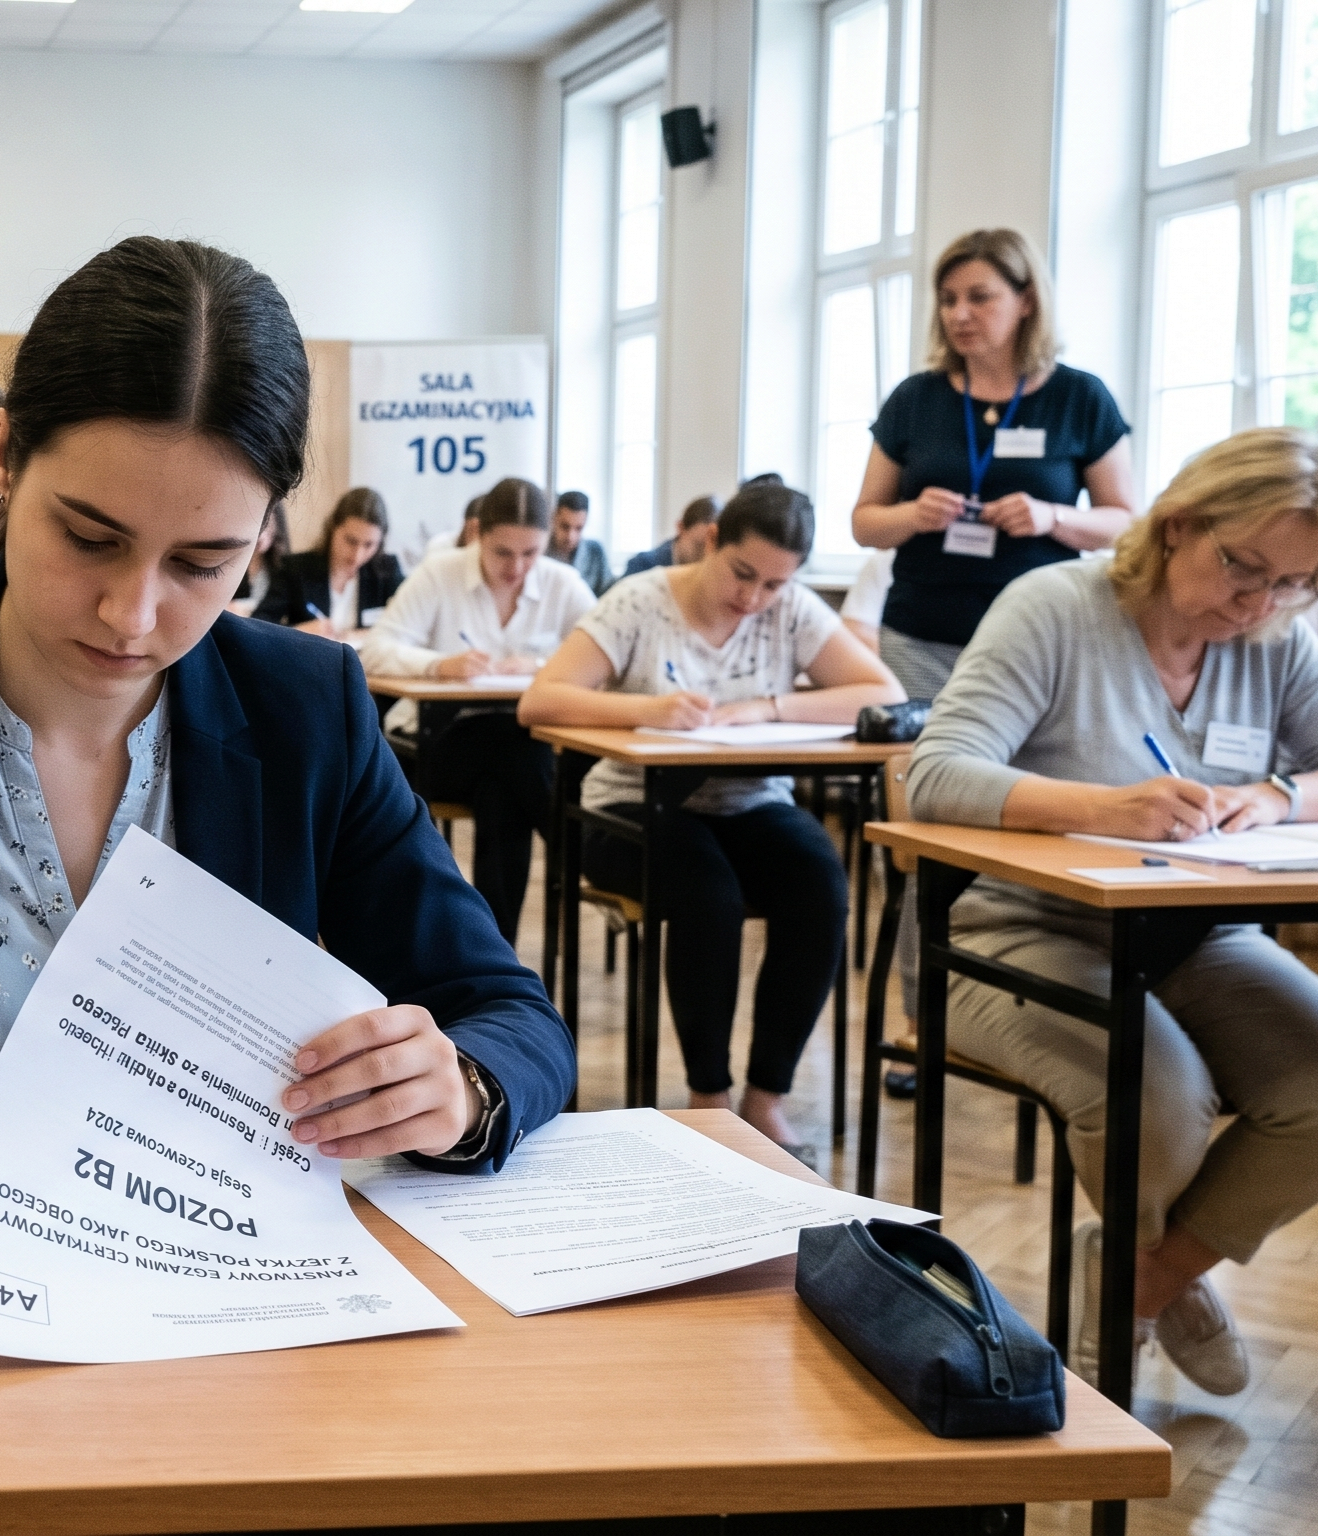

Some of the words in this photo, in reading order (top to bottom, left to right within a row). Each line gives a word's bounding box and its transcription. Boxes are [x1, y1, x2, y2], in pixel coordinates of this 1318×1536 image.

[420, 373, 474, 392] SALA
[359, 400, 535, 423] EGZAMINACYJNA
[408, 436, 486, 474] 105
[85, 1106, 125, 1137] 2024
[73, 1148, 115, 1191] B2
[210, 1168, 253, 1199] Sesja
[124, 1171, 259, 1238] POZIOM
[79, 1217, 130, 1242] JAKO
[135, 1235, 251, 1267] POLSKIEGO
[337, 1256, 353, 1265] Z
[134, 1256, 221, 1280] EGZAMIN
